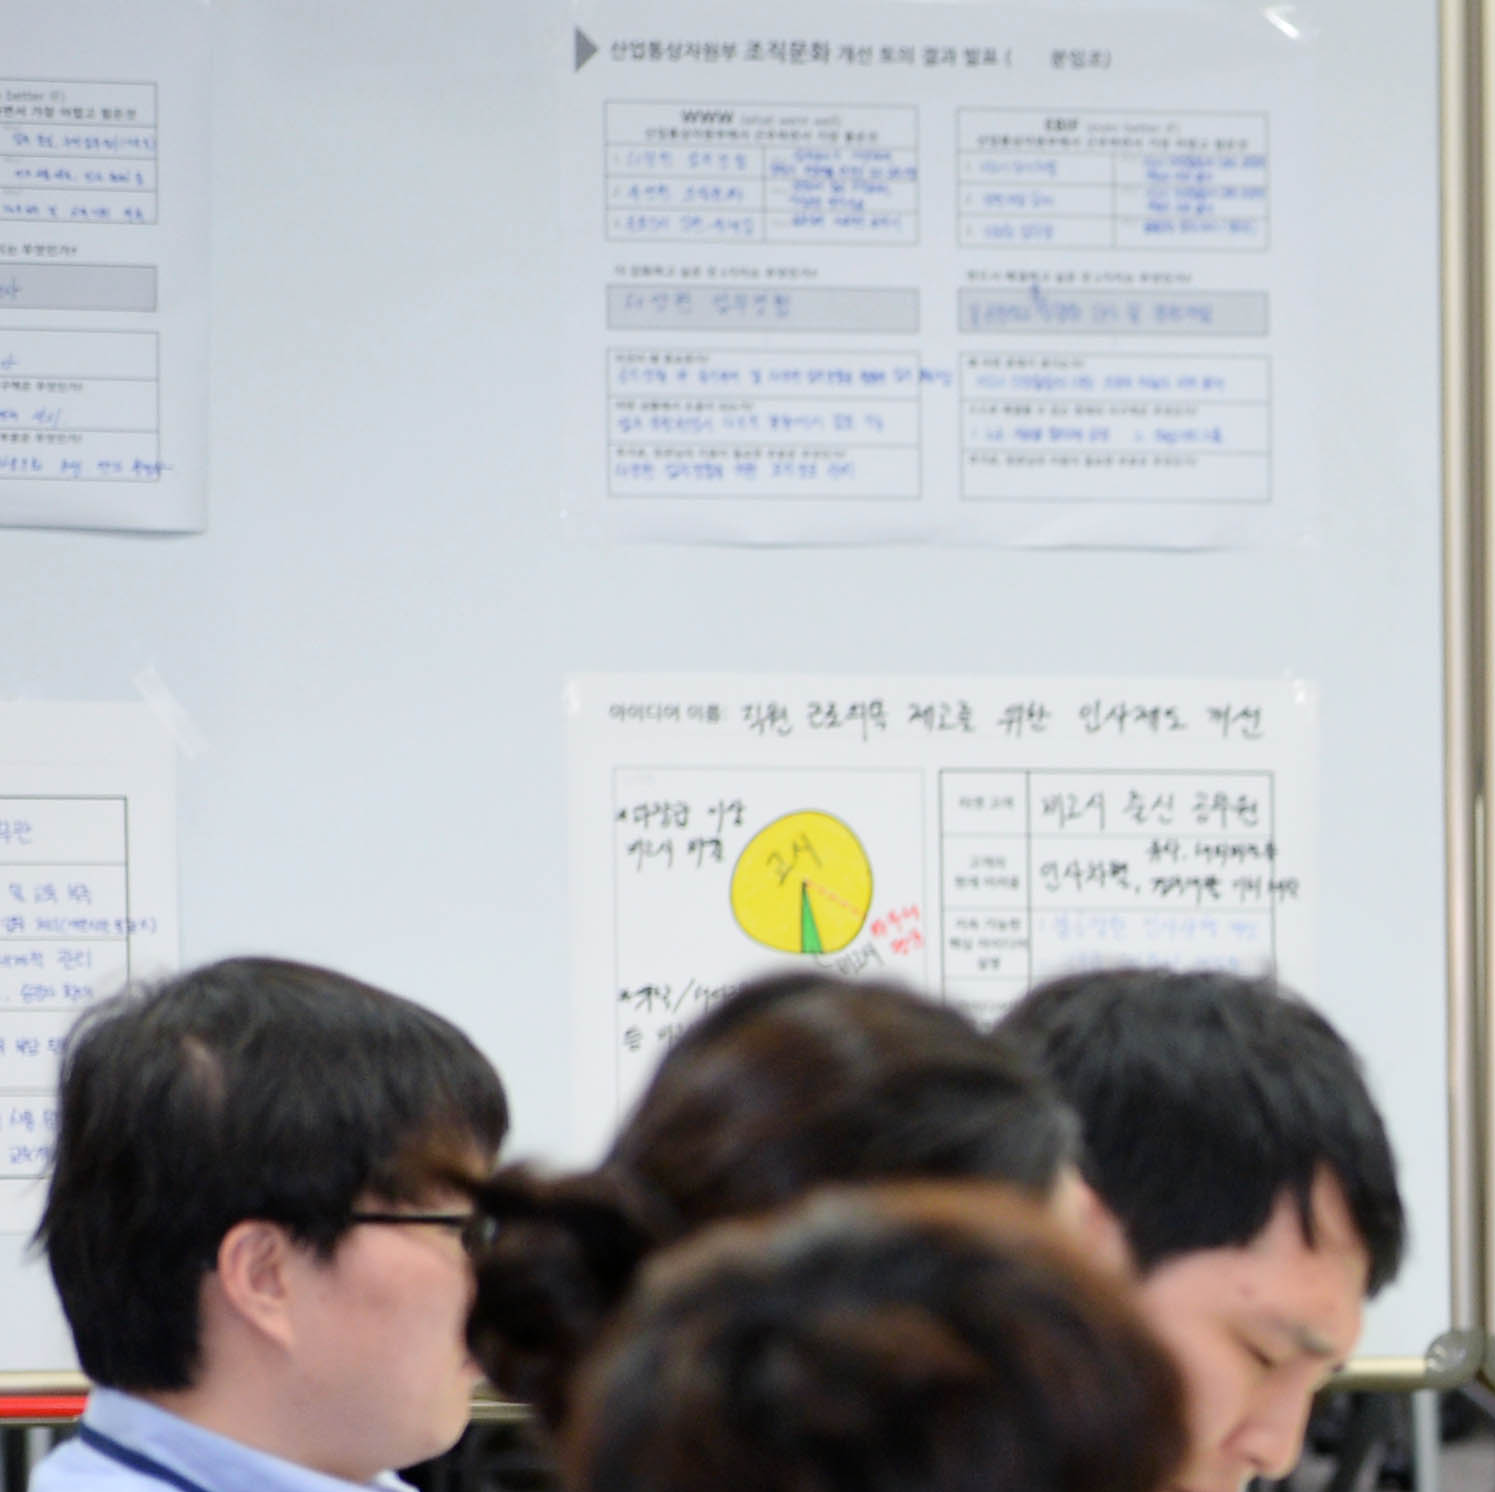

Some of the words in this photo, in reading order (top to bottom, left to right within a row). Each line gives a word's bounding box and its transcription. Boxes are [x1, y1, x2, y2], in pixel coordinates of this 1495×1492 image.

[610, 40, 738, 63] 산업통상자원부
[745, 39, 831, 63] 조직문화
[838, 46, 874, 66] 개선
[609, 701, 682, 724] 아이디어
[742, 700, 795, 737] 직원
